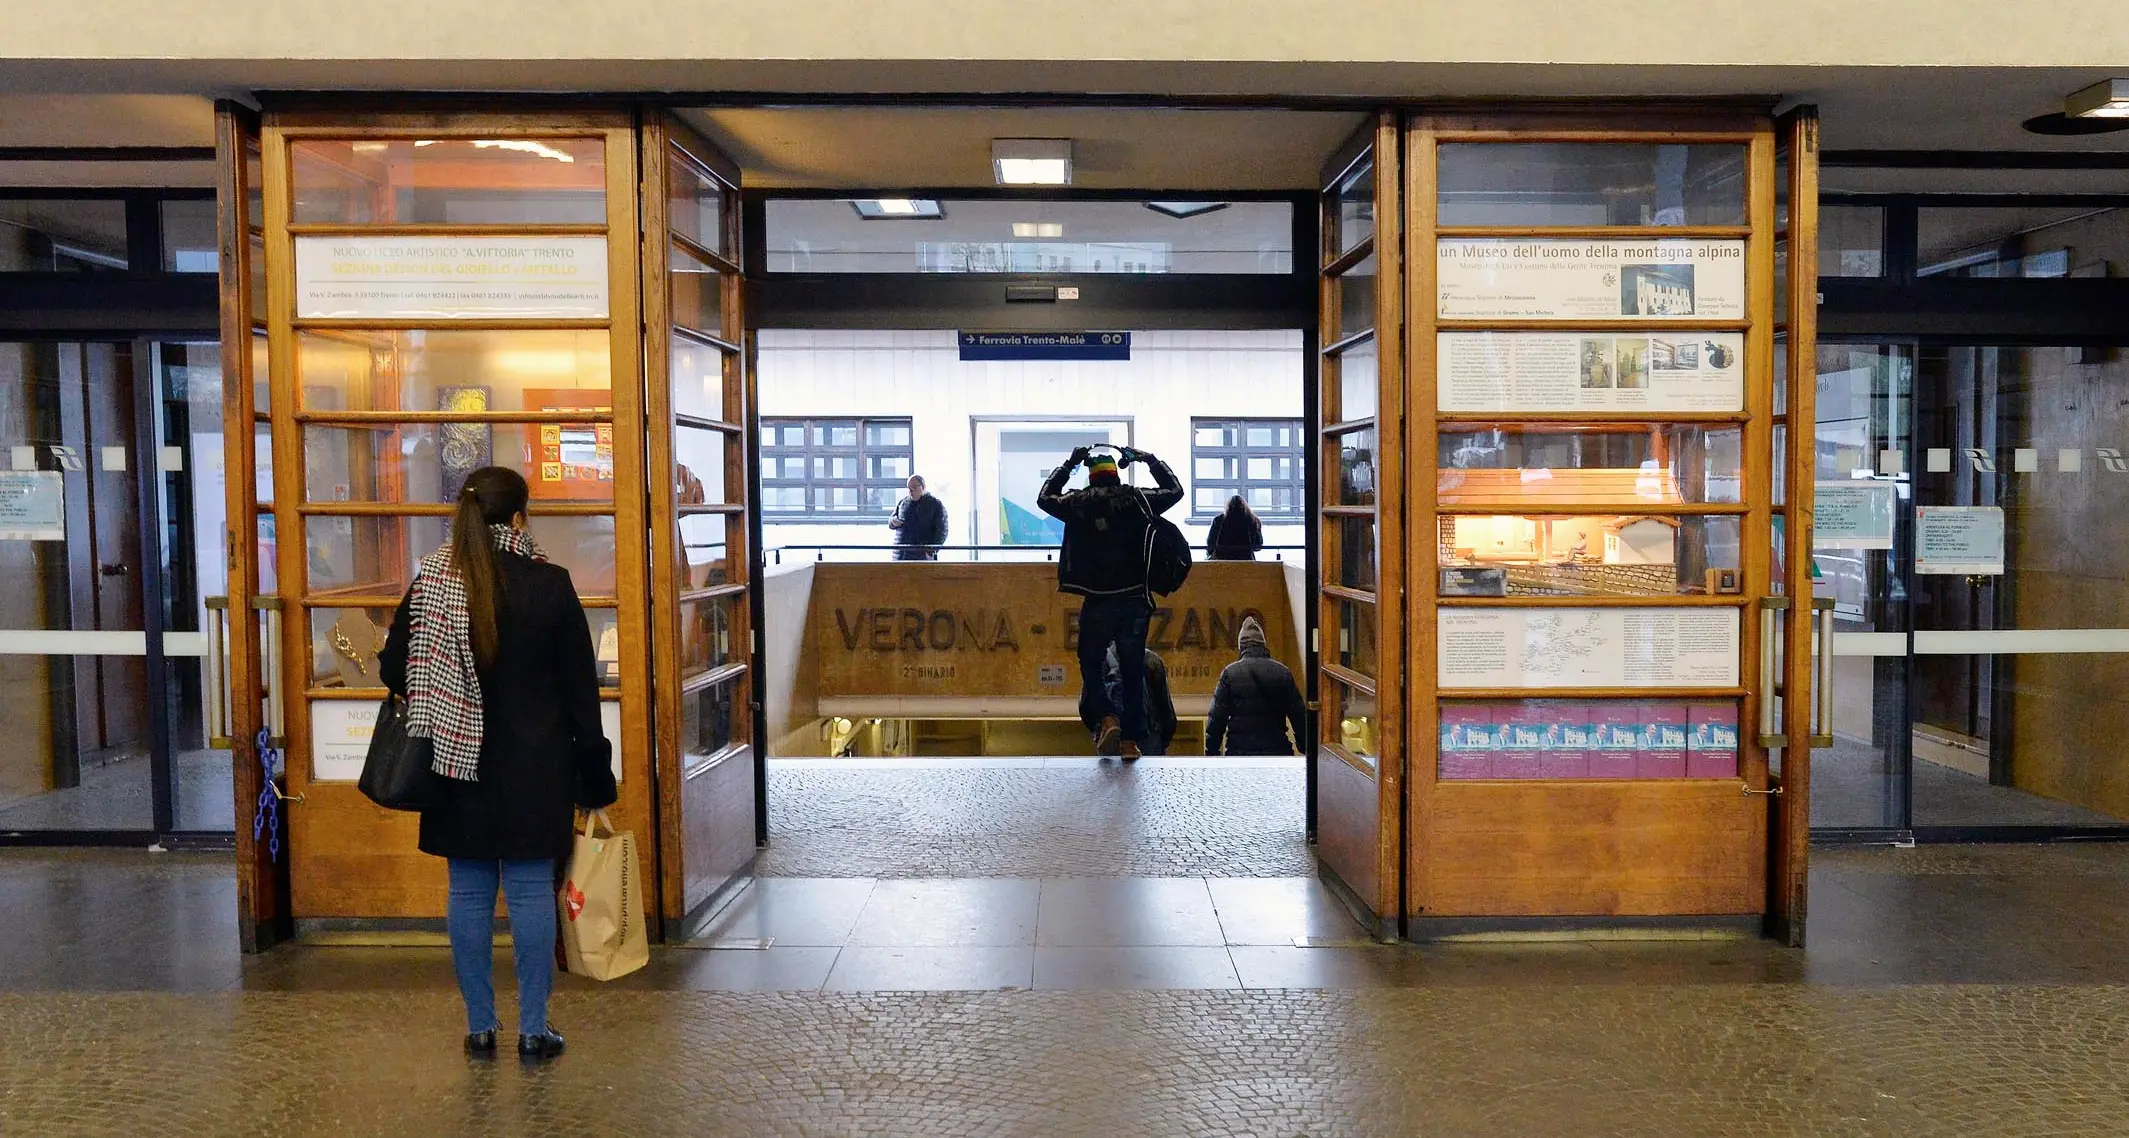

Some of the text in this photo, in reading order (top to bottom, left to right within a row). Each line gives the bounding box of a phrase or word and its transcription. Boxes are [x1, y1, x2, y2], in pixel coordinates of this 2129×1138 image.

[333, 247, 371, 258] NUOVO
[406, 247, 458, 258] ARTISTICO
[533, 247, 574, 258] TRENTO
[1440, 244, 1741, 262] un Museo dell'uomo della montagna alpina
[979, 334, 1086, 346] Ferrovia Trento-Malè
[835, 606, 1021, 653] VERONA
[917, 666, 956, 678] BINARIO
[347, 710, 378, 721] NUOV
[347, 726, 375, 737] SEZI
